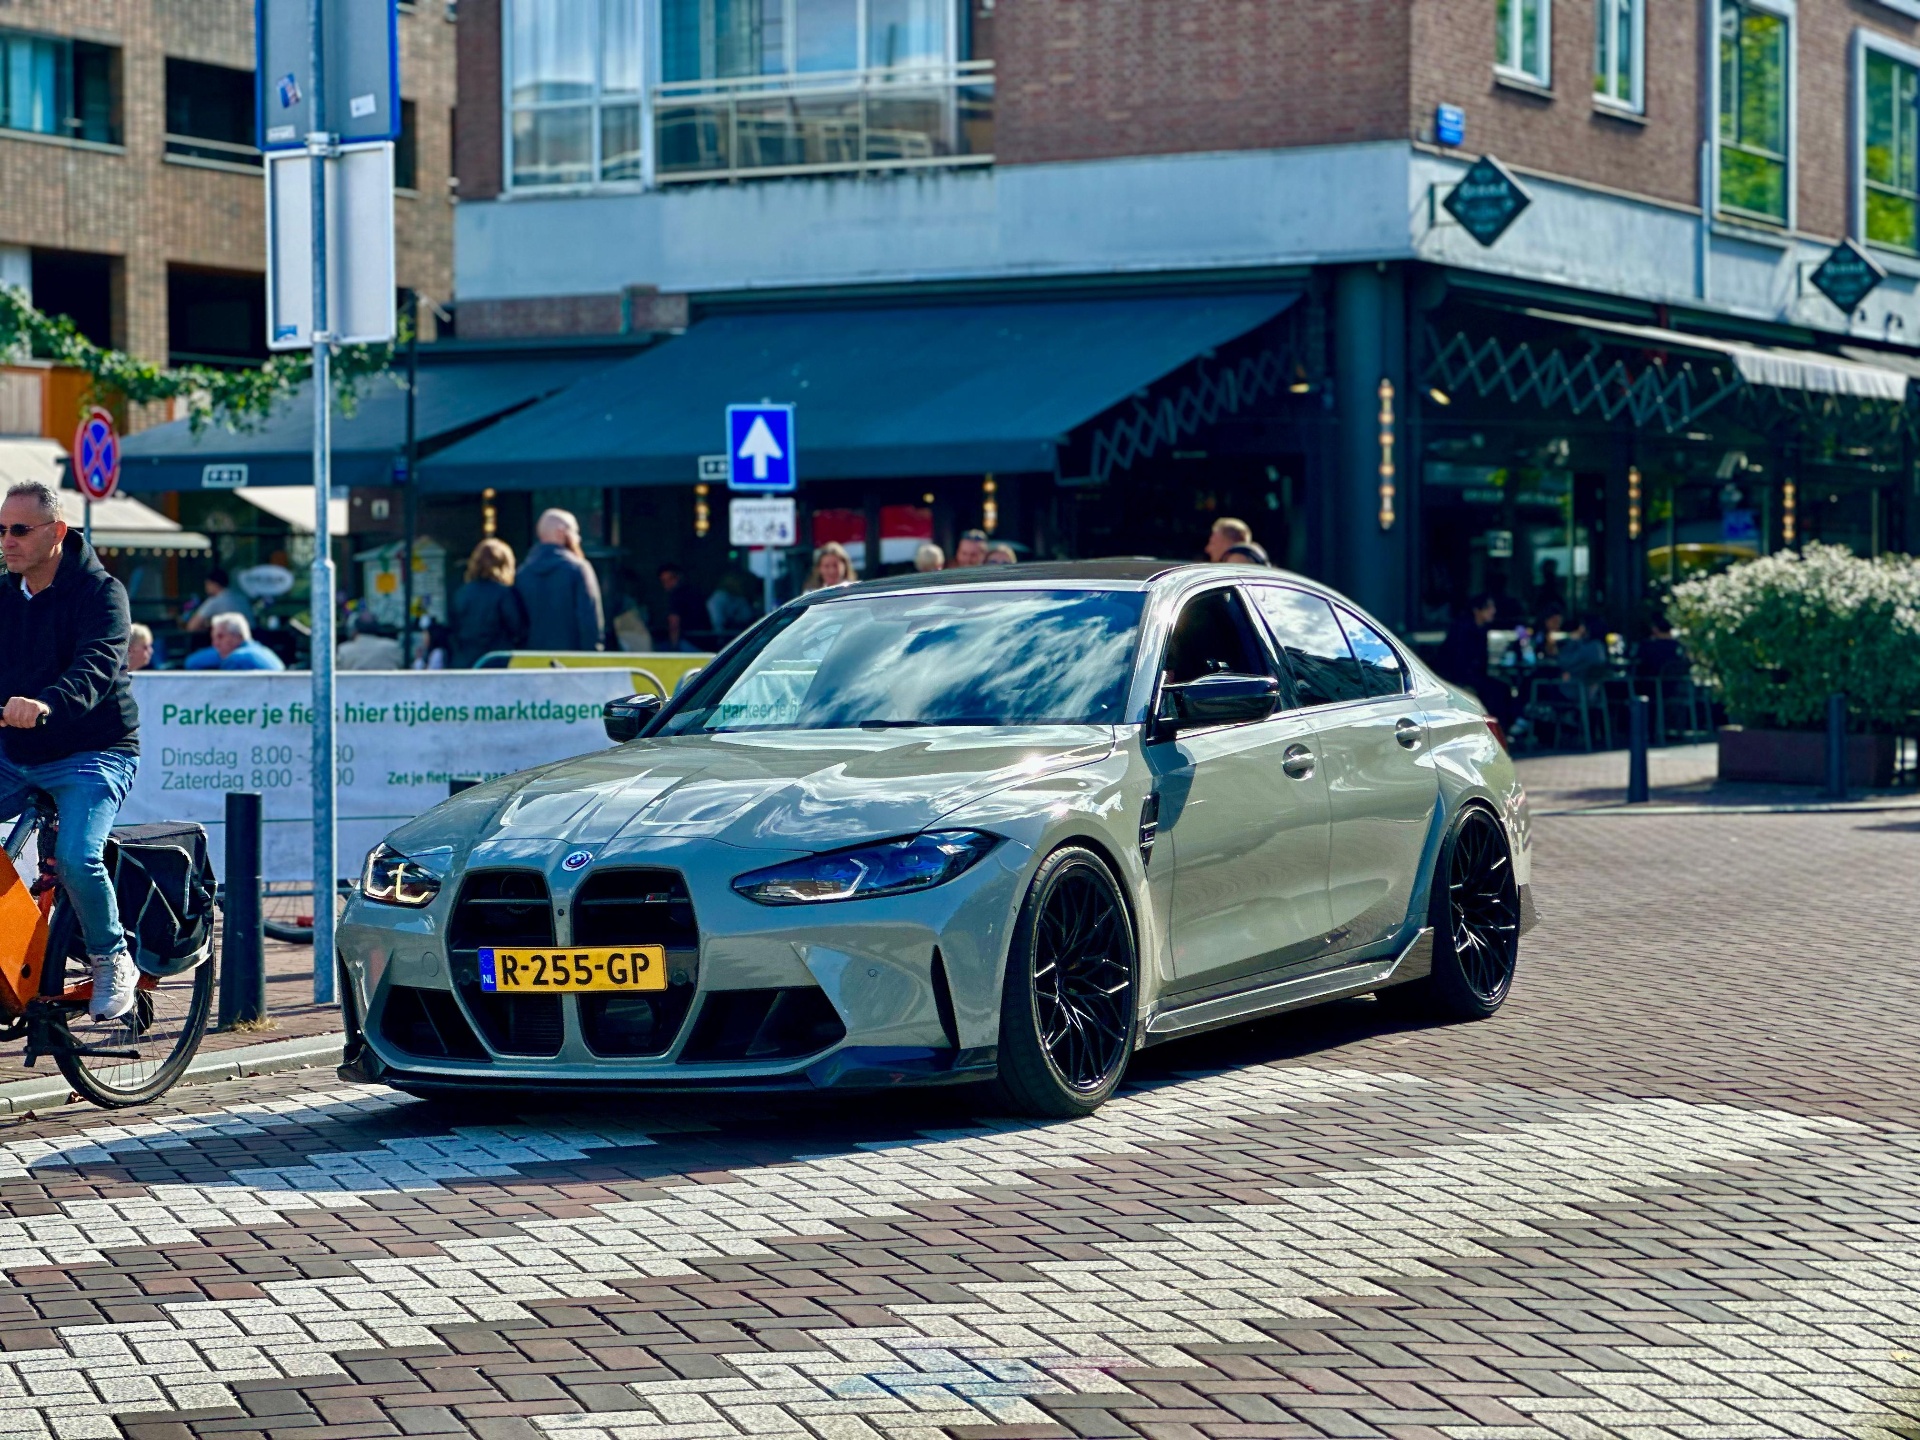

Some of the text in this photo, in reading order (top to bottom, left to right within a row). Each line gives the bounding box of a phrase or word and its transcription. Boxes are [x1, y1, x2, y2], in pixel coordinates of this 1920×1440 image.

[162, 699, 604, 729] Parkeer je fie hier tijdens marktdagen
[161, 746, 238, 769] Dinsdag
[251, 745, 292, 766] 8.00
[161, 770, 245, 792] Zaterdag
[251, 768, 292, 789] 8.00
[387, 771, 411, 785] Zet
[412, 770, 423, 785] je
[482, 952, 650, 986] NL R-255-GP
